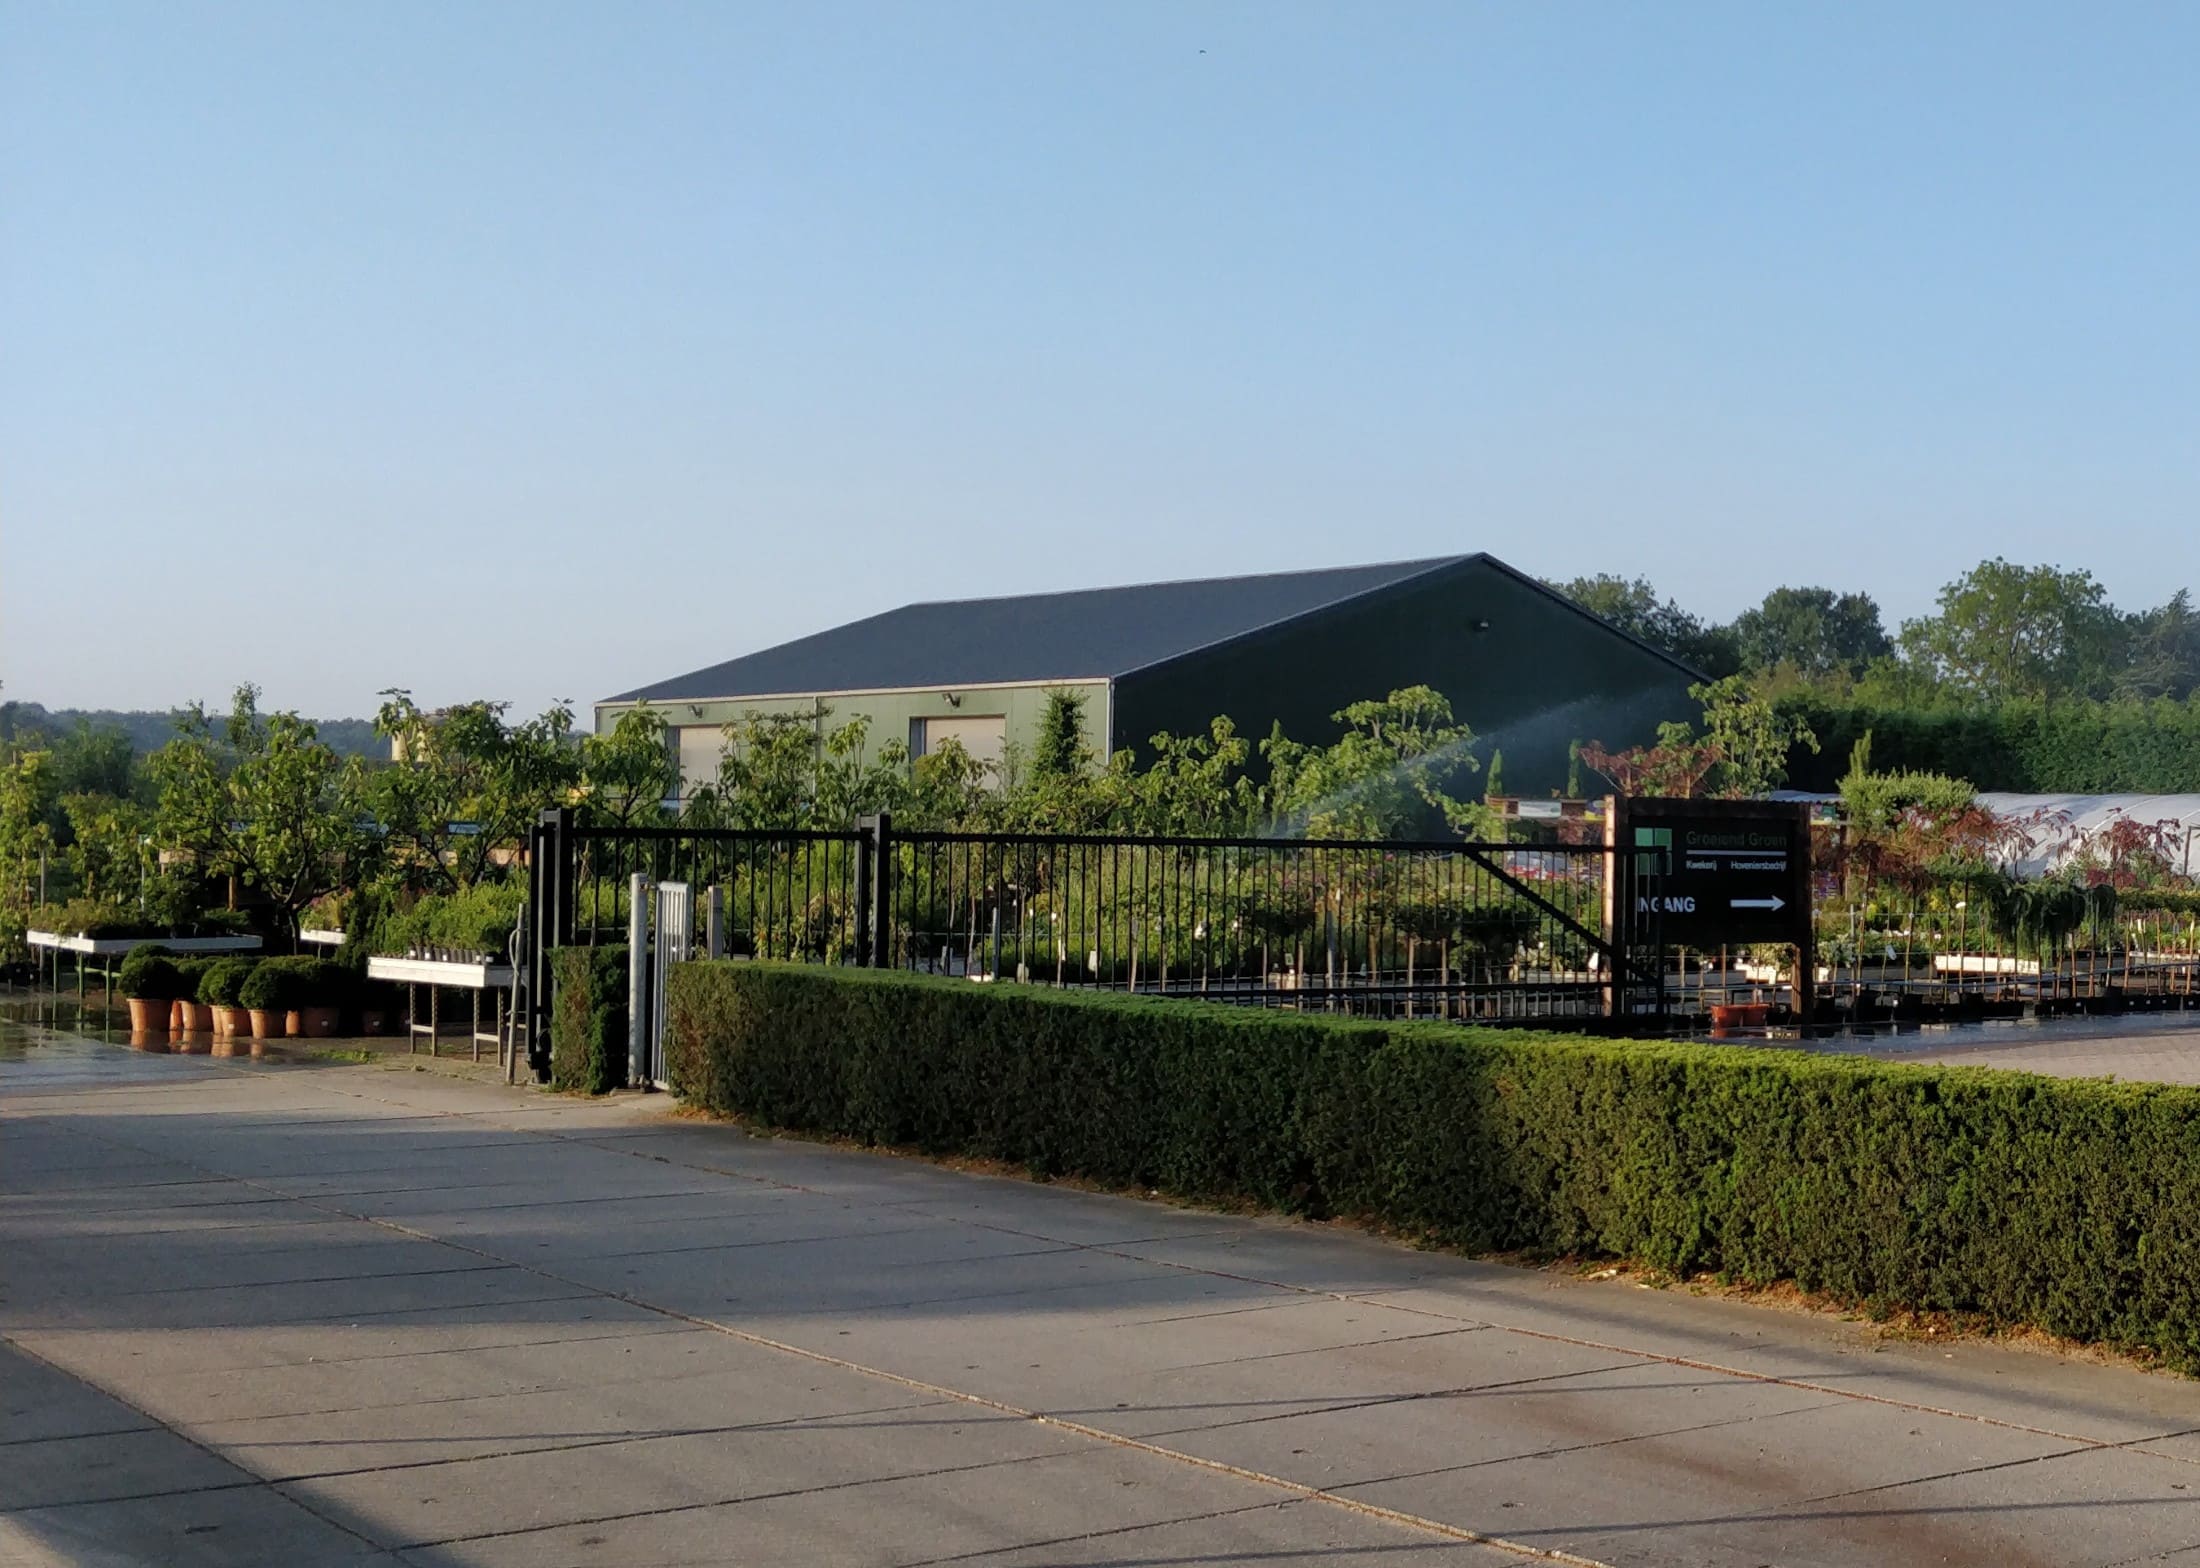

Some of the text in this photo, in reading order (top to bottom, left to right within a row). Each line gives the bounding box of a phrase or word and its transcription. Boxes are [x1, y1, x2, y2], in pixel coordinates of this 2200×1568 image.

[1749, 832, 1787, 848] Groen
[1686, 860, 1786, 872] Kwekerij Hoveniersbedrijf
[1637, 896, 1695, 912] INGANG
